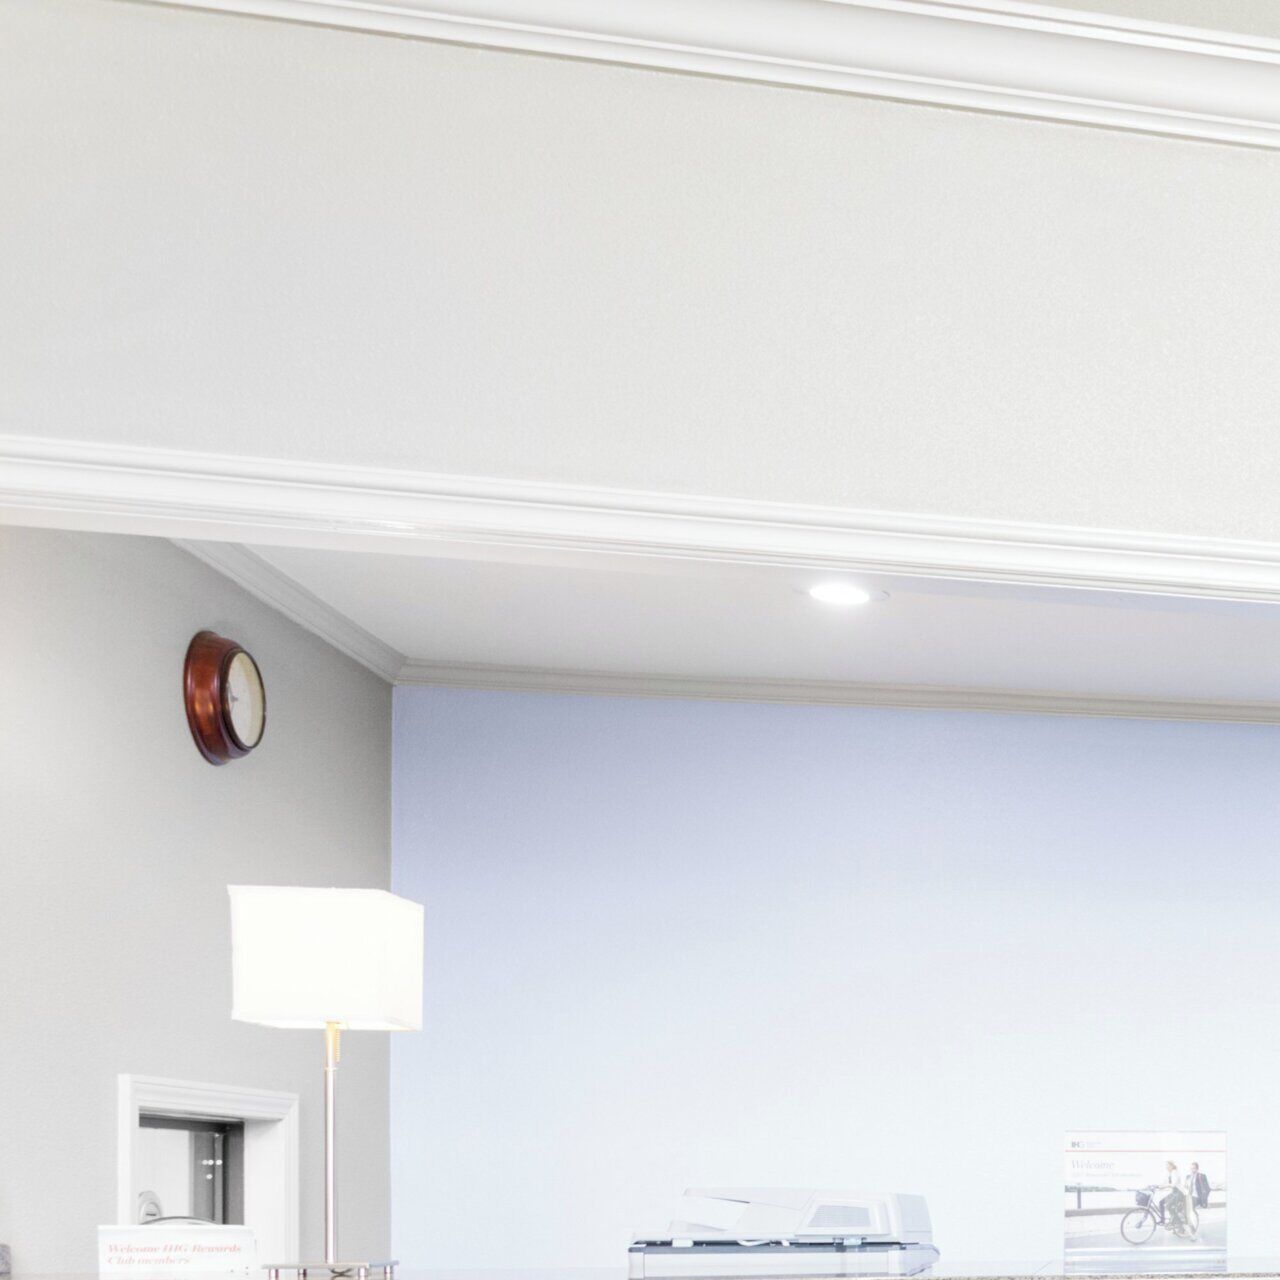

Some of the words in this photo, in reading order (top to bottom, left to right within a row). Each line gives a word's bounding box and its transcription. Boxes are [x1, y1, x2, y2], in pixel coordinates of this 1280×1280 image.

[107, 1243, 160, 1253] Welcome
[162, 1243, 188, 1253] IHG
[192, 1243, 242, 1253] Rewards
[107, 1256, 135, 1265] Club
[137, 1255, 190, 1265] members
